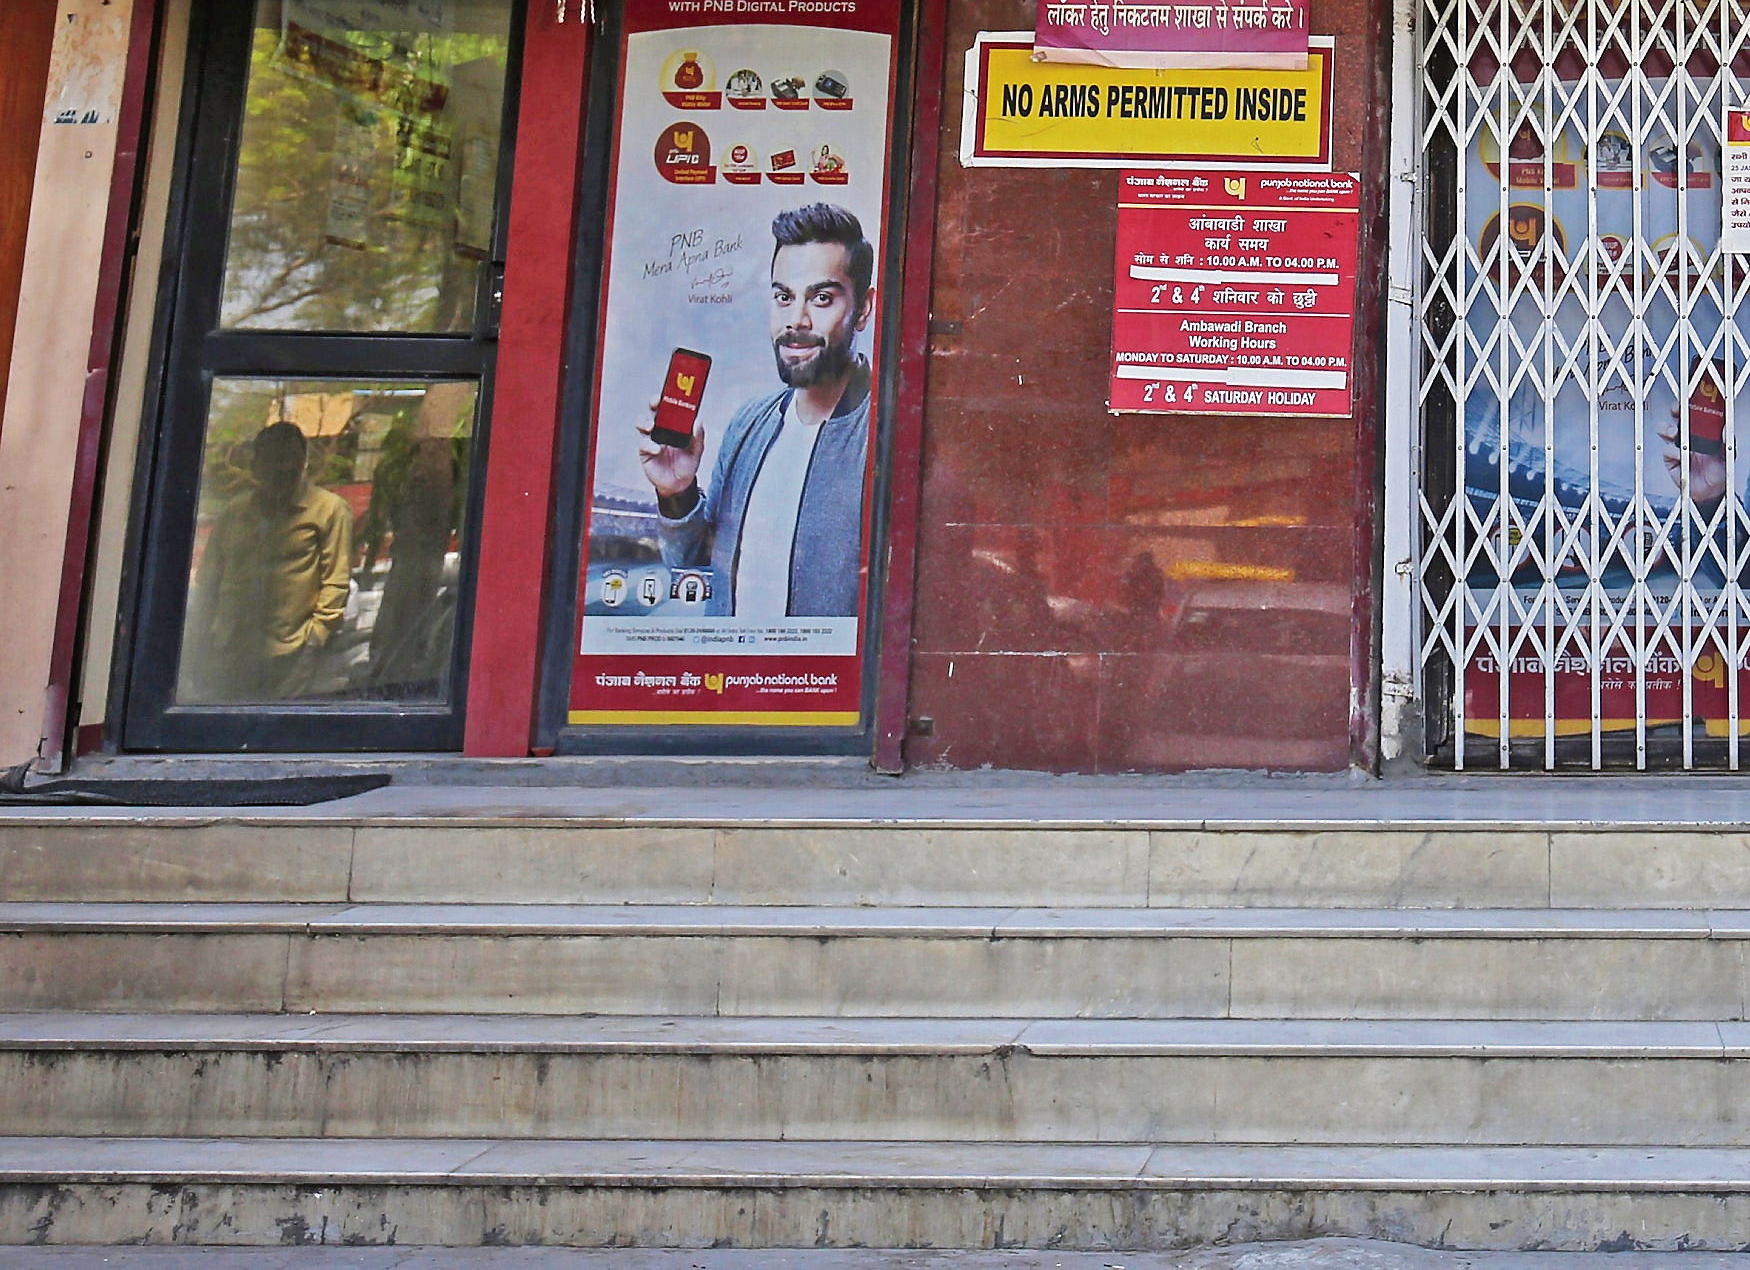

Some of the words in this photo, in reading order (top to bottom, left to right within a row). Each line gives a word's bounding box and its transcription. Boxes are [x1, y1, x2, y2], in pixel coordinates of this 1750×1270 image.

[703, 0, 733, 12] PNB
[1174, 4, 1212, 30] शाखा
[1002, 84, 1033, 117] NO
[1039, 84, 1100, 119] ARMS
[1106, 85, 1229, 121] PERMITTED
[1235, 87, 1307, 122] INSIDE
[1260, 178, 1292, 189] punjab
[1292, 179, 1329, 188] national
[1331, 179, 1354, 189] bank
[1189, 214, 1245, 232] आंबावाडी
[1252, 218, 1287, 232] शाखा
[669, 229, 704, 257] PNB
[713, 234, 743, 258] Bank
[1205, 233, 1231, 250] कार्य
[1238, 237, 1269, 251] समय
[1134, 252, 1153, 265] सोम
[1159, 252, 1169, 265] से
[1175, 254, 1194, 266] शनि
[1206, 256, 1236, 267] 10.00
[1238, 256, 1263, 267] A.M.
[1265, 257, 1282, 268] TO
[1285, 257, 1314, 268] 04.00
[1316, 258, 1340, 269] P.M.
[688, 294, 708, 304] Virat
[710, 294, 733, 304] Kohli
[1172, 288, 1184, 303] &
[1212, 287, 1259, 304] शनिवार
[1267, 288, 1284, 304] को
[1180, 320, 1242, 333] Ambawadi
[1244, 321, 1287, 334] Branch
[1189, 336, 1238, 350] Working
[1240, 337, 1276, 349] Hours
[1115, 352, 1158, 363] MONDAY
[1161, 353, 1174, 363] TO
[1176, 353, 1229, 364] SATURDAY
[1236, 355, 1261, 365] 10.00
[1262, 355, 1284, 366] A.M.
[1286, 356, 1299, 366] TO
[1301, 356, 1327, 367] 04.00
[1328, 357, 1347, 367] P.M.
[1164, 386, 1176, 402] &
[1204, 390, 1264, 405] SATURDAY
[1268, 391, 1316, 405] HOLIDAY
[595, 672, 631, 687] पंजाब
[725, 673, 763, 688] punjab
[764, 673, 809, 686] national
[811, 673, 837, 686] bank
